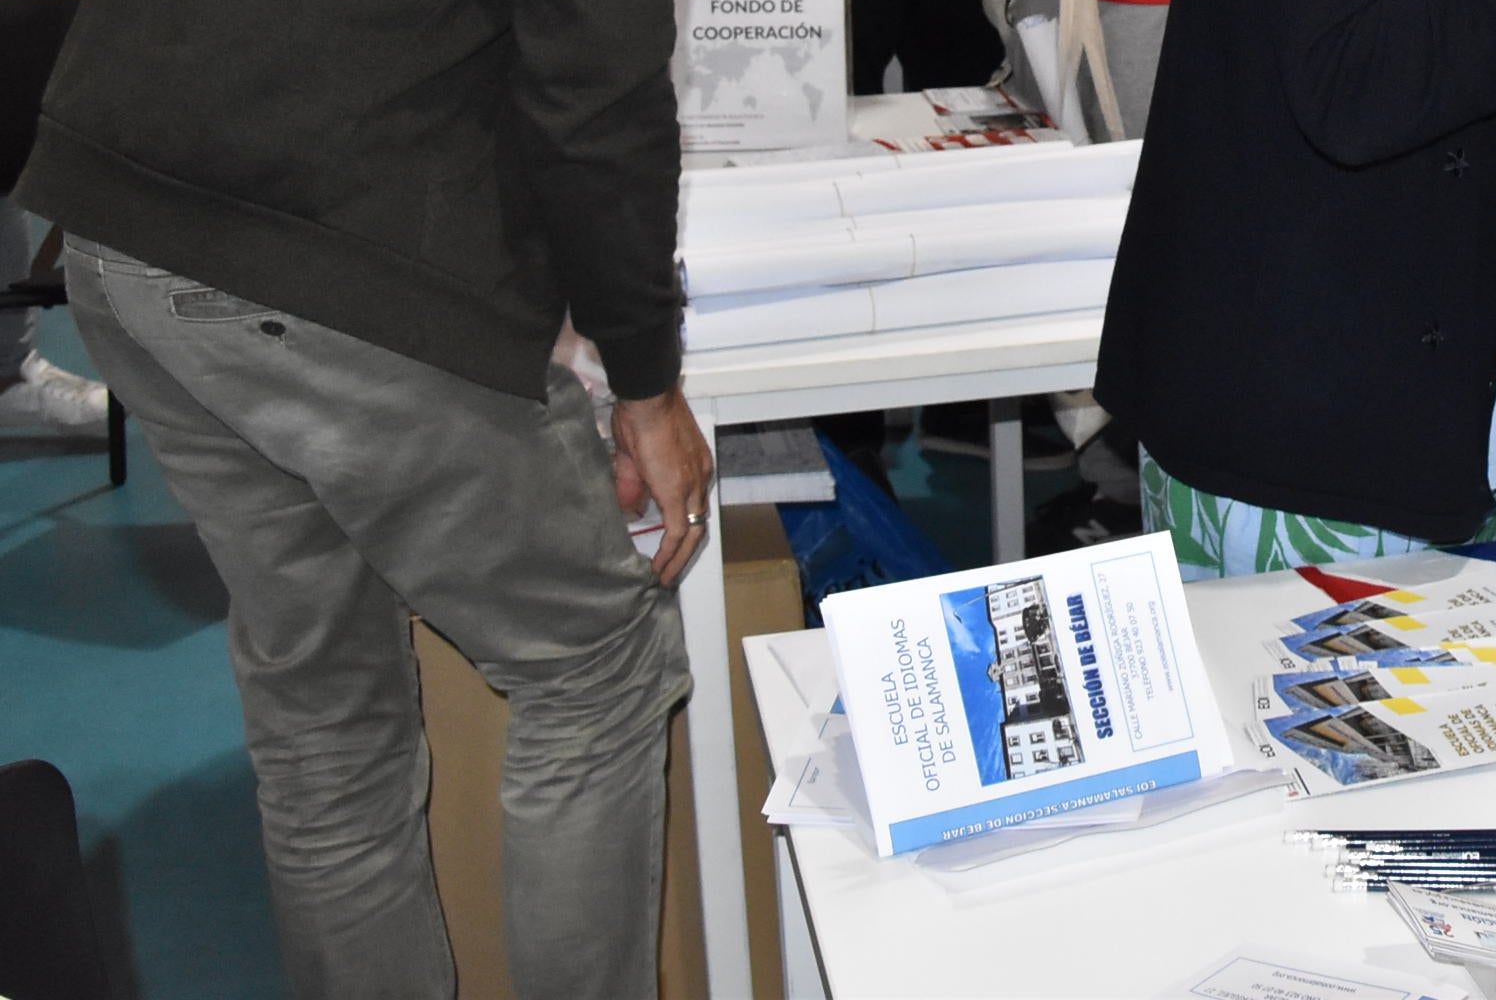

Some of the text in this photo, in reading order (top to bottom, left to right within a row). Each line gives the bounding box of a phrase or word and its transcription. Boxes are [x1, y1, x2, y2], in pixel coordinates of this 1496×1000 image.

[710, 0, 804, 14] FONDO DE
[692, 21, 823, 41] COOPERACIÓN
[1126, 602, 1135, 612] 50
[1128, 615, 1138, 625] 07
[1135, 640, 1144, 655] 923
[1066, 593, 1114, 739] SECCIÓN DE BÉJAR
[917, 636, 957, 764] DE SALAMANCA
[1121, 672, 1136, 713] MARIANO
[881, 671, 908, 745] ESCUELA
[891, 618, 940, 792] OFICIAL DE IDIOMAS
[1460, 708, 1476, 720] DE
[1130, 712, 1143, 740] CALLE
[1448, 713, 1485, 754] OFICIAL DE
[1440, 723, 1470, 757] ESCUELA
[1137, 779, 1157, 791] EOI
[943, 823, 982, 841] BEJAR
[987, 818, 1002, 830] DE
